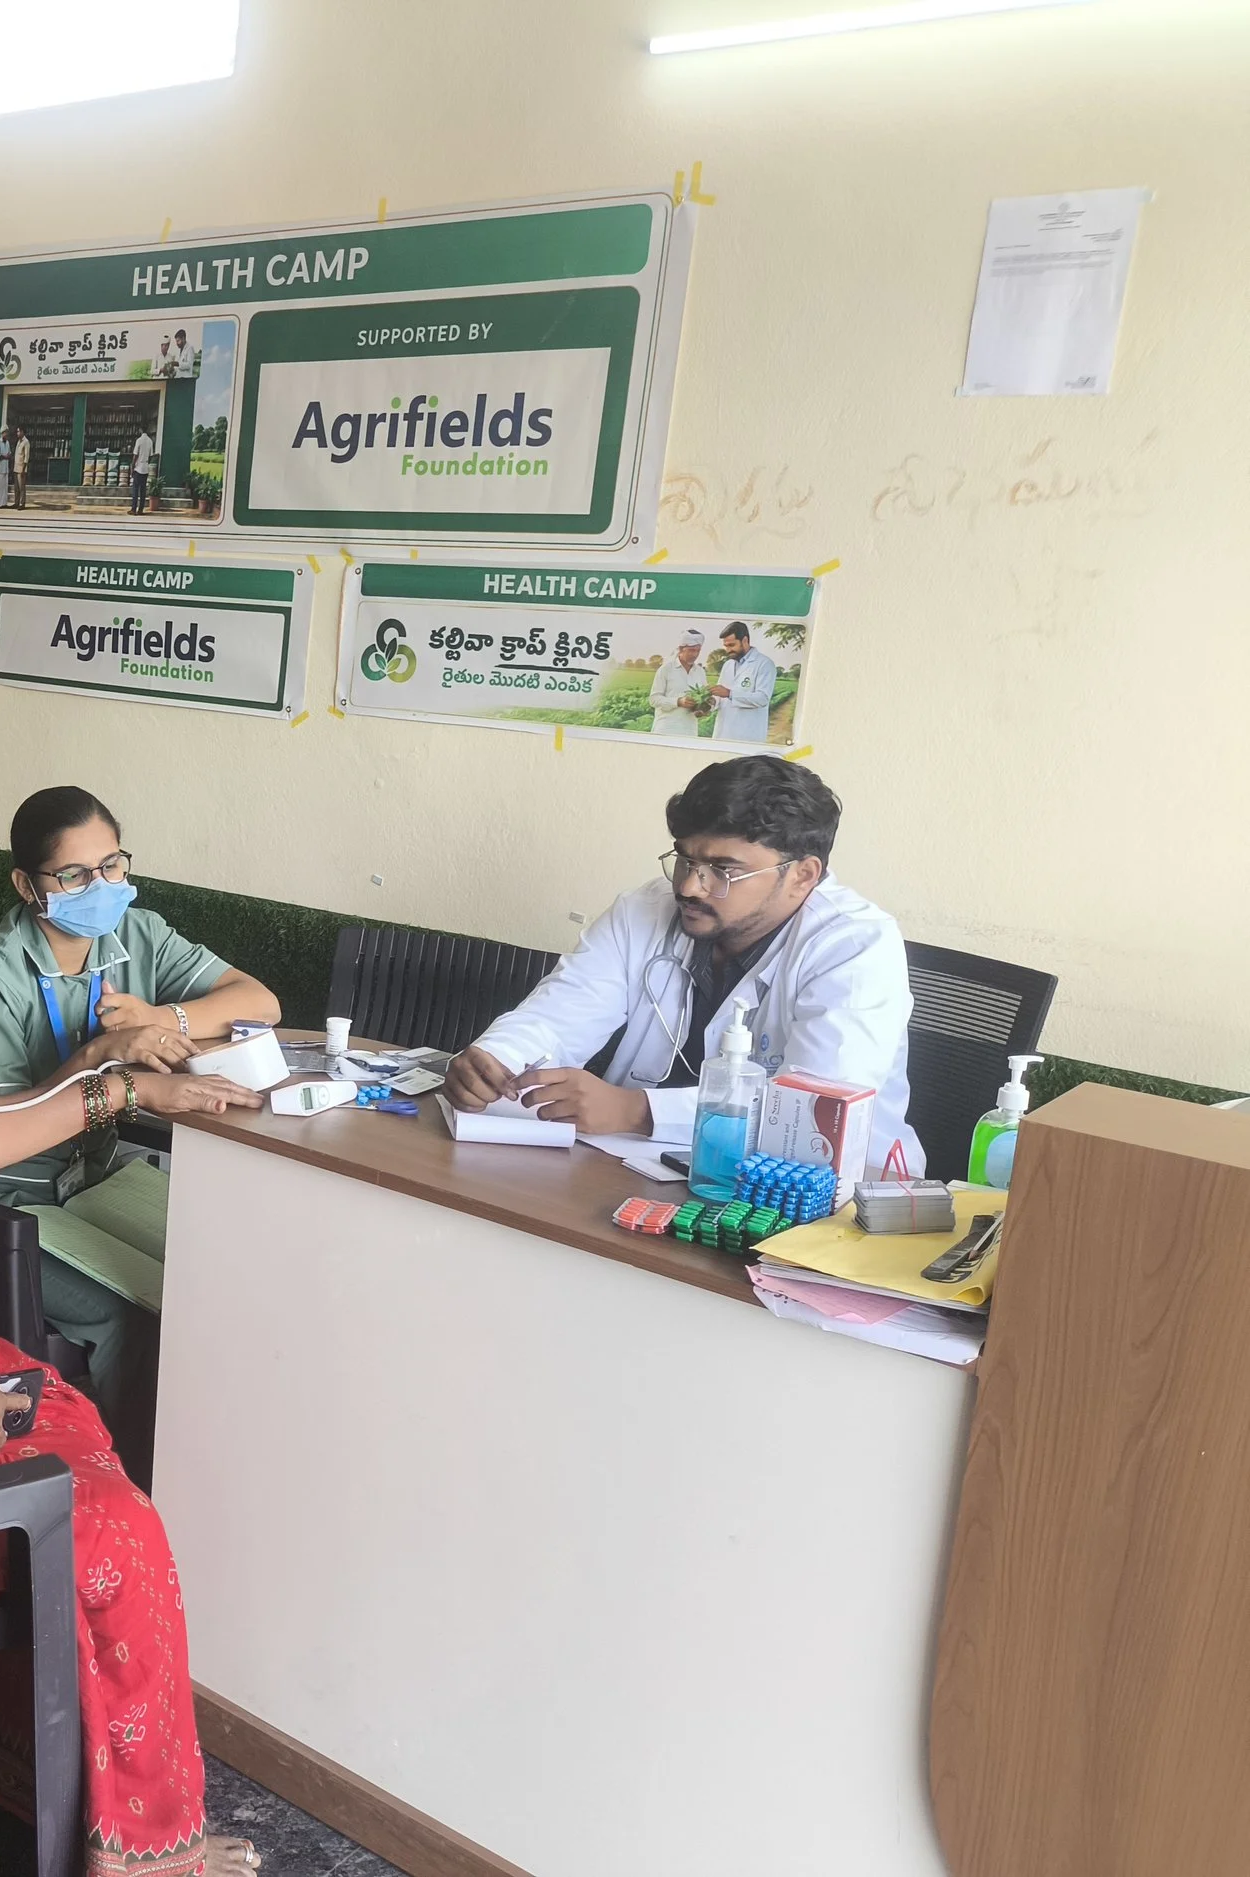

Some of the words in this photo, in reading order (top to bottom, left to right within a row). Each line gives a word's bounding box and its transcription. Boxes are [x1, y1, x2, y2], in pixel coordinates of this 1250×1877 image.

[132, 257, 254, 297] HEALTH
[266, 247, 369, 287] CAMP
[29, 339, 63, 361] కల్టివా
[68, 333, 92, 357] క్రాప్
[98, 330, 129, 358] క్లినిక్
[357, 324, 461, 346] SUPPORTED
[468, 322, 493, 340] BY
[291, 392, 553, 464] Agrifields
[401, 452, 548, 476] Foundation
[76, 566, 138, 586] HEALTH
[142, 570, 194, 590] CAMP
[483, 574, 577, 597] HEALTH
[583, 577, 657, 600] CAMP
[51, 614, 216, 662] Agrifields
[428, 626, 494, 661] కల్టివా
[500, 628, 547, 661] క్రాప్
[552, 631, 613, 667] క్లినిక్
[120, 658, 214, 683] Foundation
[442, 667, 484, 688] రైతుల
[489, 670, 540, 690] మొదటి
[545, 677, 593, 694] ఎంపిక
